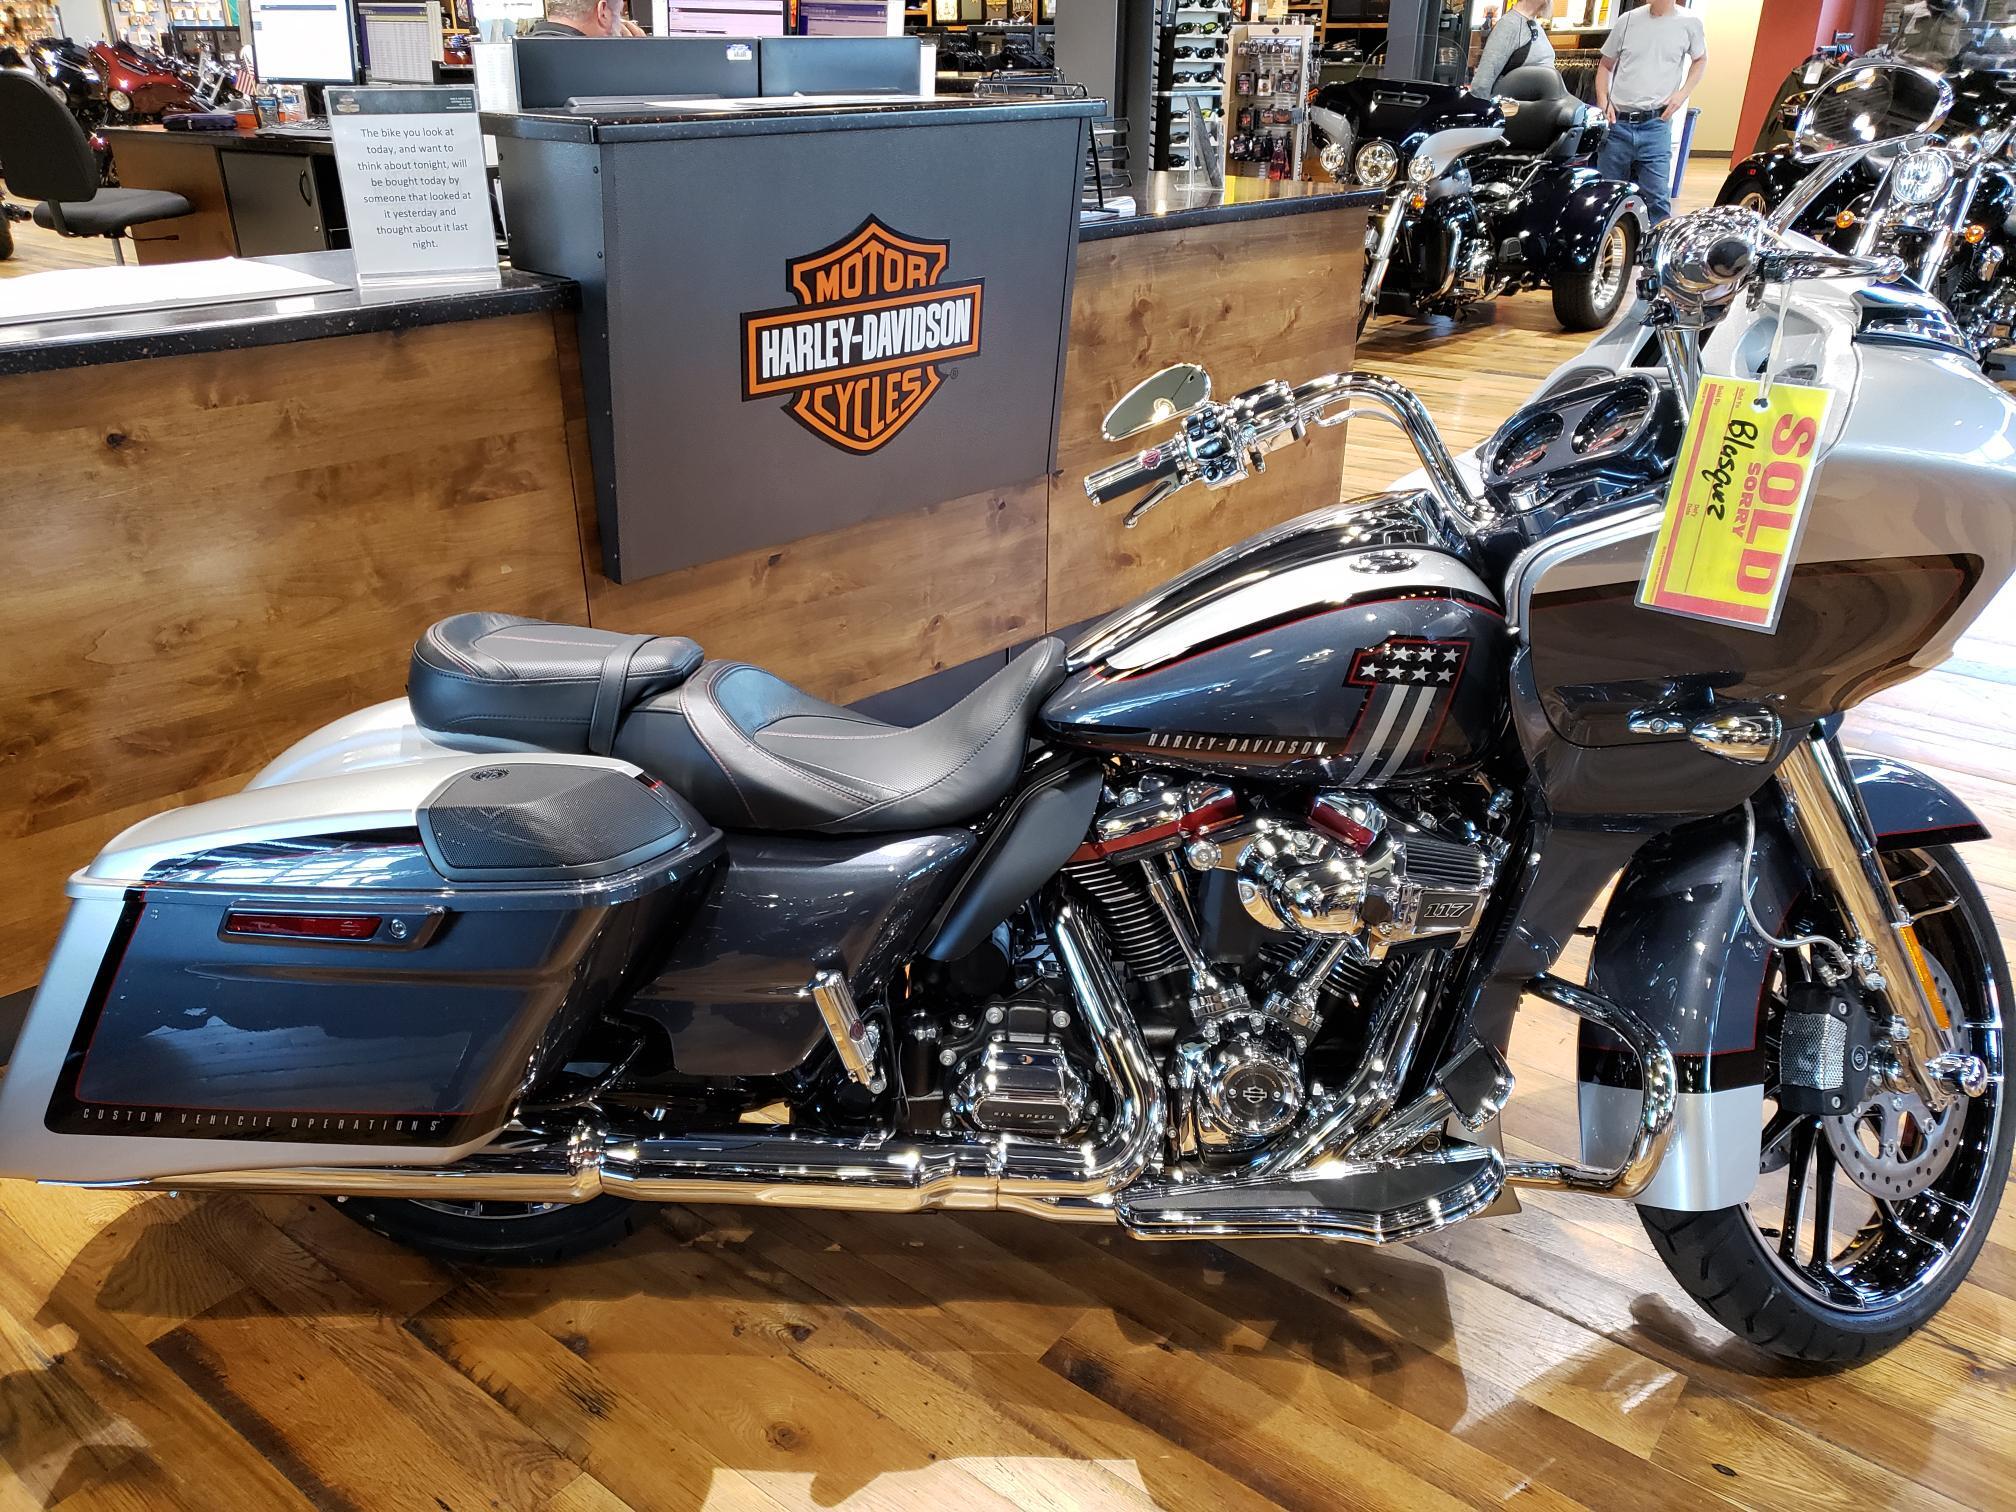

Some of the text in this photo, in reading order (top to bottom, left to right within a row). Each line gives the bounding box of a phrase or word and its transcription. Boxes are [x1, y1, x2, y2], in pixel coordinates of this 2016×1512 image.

[360, 127, 455, 139] The bike you look at
[367, 144, 454, 156] today, and want to
[358, 159, 468, 171] think about tonight, will
[371, 175, 460, 188] be bought today by
[363, 191, 472, 203] someone that looked at
[384, 207, 457, 220] it yesterday and
[377, 221, 469, 236] thought about it last
[412, 239, 439, 250] night.
[816, 239, 928, 302] MOTOR
[761, 298, 972, 379] HARLEY-DAVIDSON
[813, 368, 923, 439] CYCLES
[1732, 462, 1762, 539] SORRY
[1736, 413, 1817, 595] SOLD
[1147, 732, 1328, 756] HARLEY-DAVIDSON
[1423, 902, 1474, 918] 117
[83, 1107, 438, 1132] CUSTOM VEHICLE OPERATIONS
